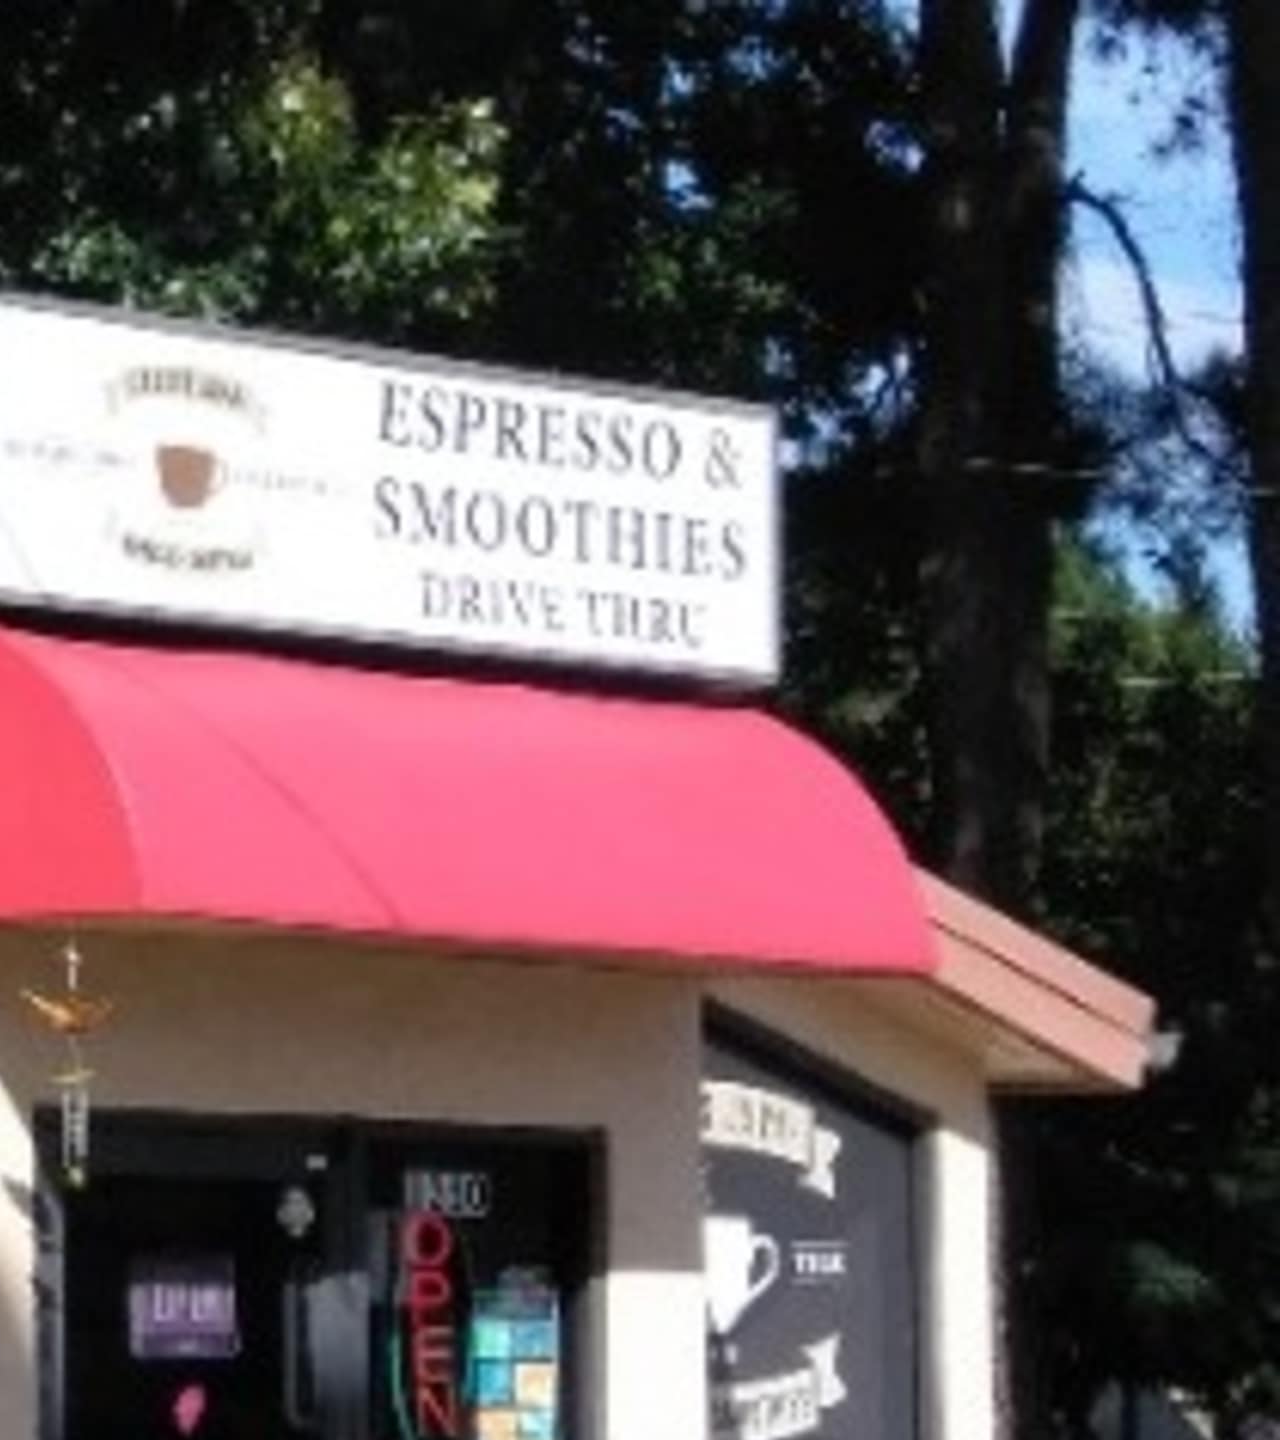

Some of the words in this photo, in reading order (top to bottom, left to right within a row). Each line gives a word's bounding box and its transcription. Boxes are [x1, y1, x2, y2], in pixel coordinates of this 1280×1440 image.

[378, 379, 683, 482] ESPRESSO
[703, 426, 743, 490] &
[374, 475, 747, 582] SMOOTHIES
[419, 570, 566, 632] DRIVE
[399, 1208, 458, 1440] OPEN
